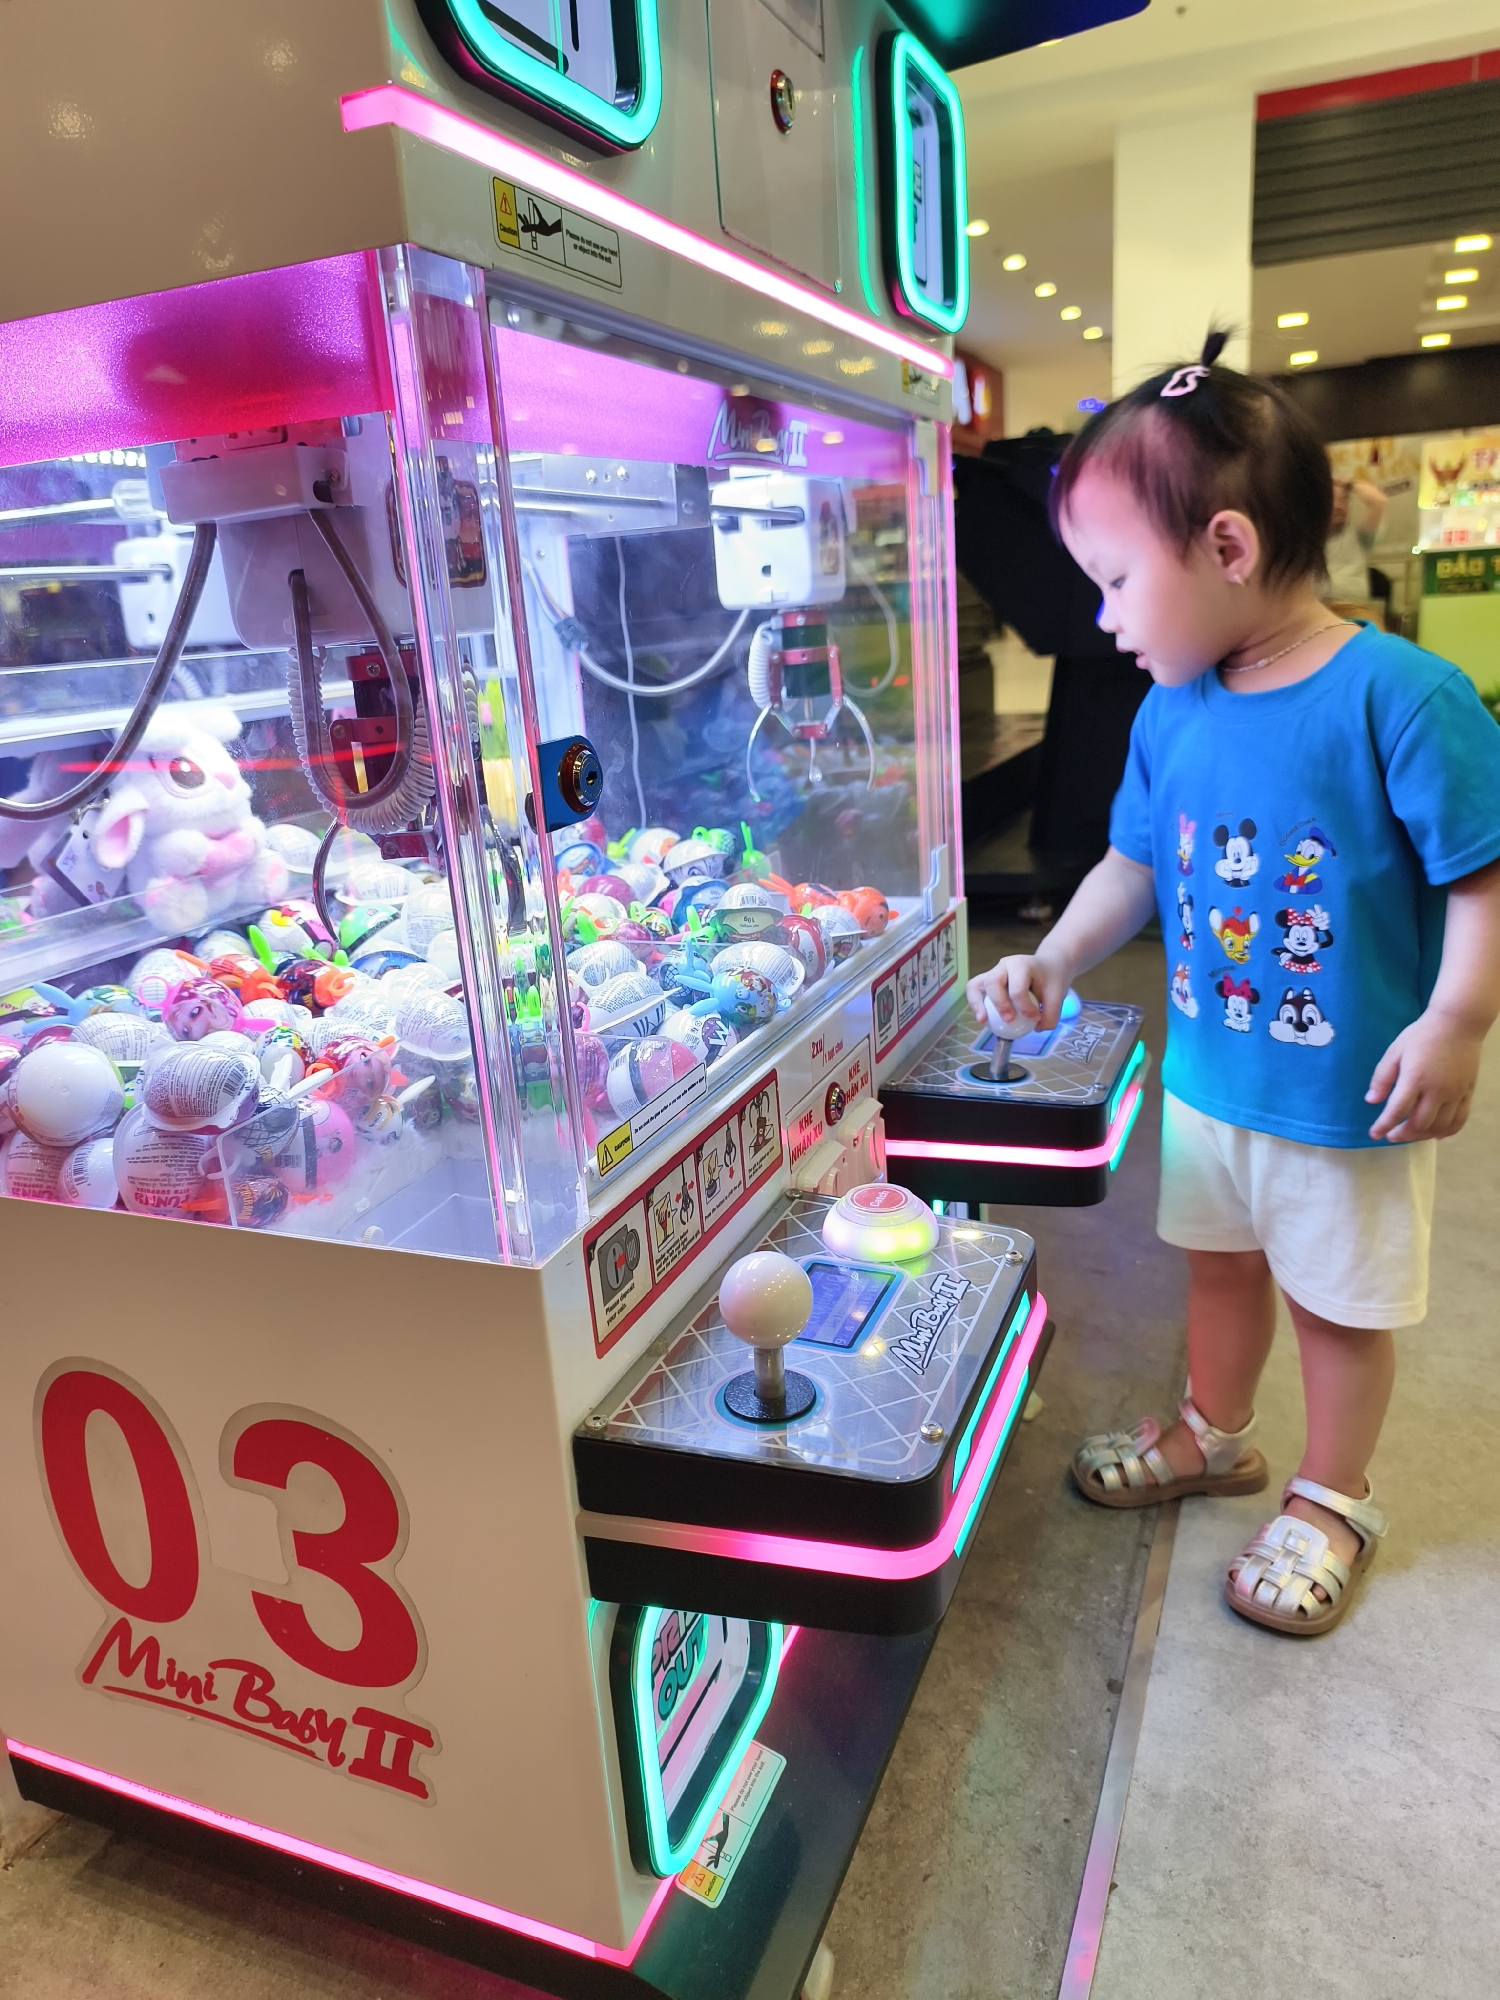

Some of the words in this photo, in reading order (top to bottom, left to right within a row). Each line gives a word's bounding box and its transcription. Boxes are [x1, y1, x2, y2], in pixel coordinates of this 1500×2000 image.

[499, 222, 518, 237] Caution
[787, 419, 809, 468] II
[1278, 822, 1299, 847] Donald
[1298, 816, 1317, 830] Duck
[1207, 964, 1236, 980] Minnie
[848, 1060, 860, 1083] KHE
[860, 1070, 869, 1089] XU
[798, 1109, 813, 1134] KHE
[614, 1134, 631, 1152] CAUTION
[698, 1150, 704, 1160] 3
[791, 1136, 812, 1165] NHẬN
[813, 1120, 823, 1144] XU
[869, 1190, 890, 1208] Catch
[605, 1298, 620, 1316] Please
[619, 1282, 636, 1301] deposit
[930, 1273, 972, 1301] II
[606, 1311, 617, 1327] your
[910, 1293, 960, 1330] Baby
[890, 1325, 934, 1376] Mini
[41, 1370, 419, 1689] 03
[651, 1610, 700, 1692] PRI
[657, 1613, 706, 1721] OUT
[81, 1617, 219, 1705] Mini
[208, 1658, 348, 1768] Baby
[347, 1706, 435, 1800] II
[729, 1793, 741, 1811] Please
[750, 1761, 758, 1772] your
[755, 1749, 763, 1761] hand
[743, 1787, 753, 1801] object
[704, 1874, 718, 1896] Caution
